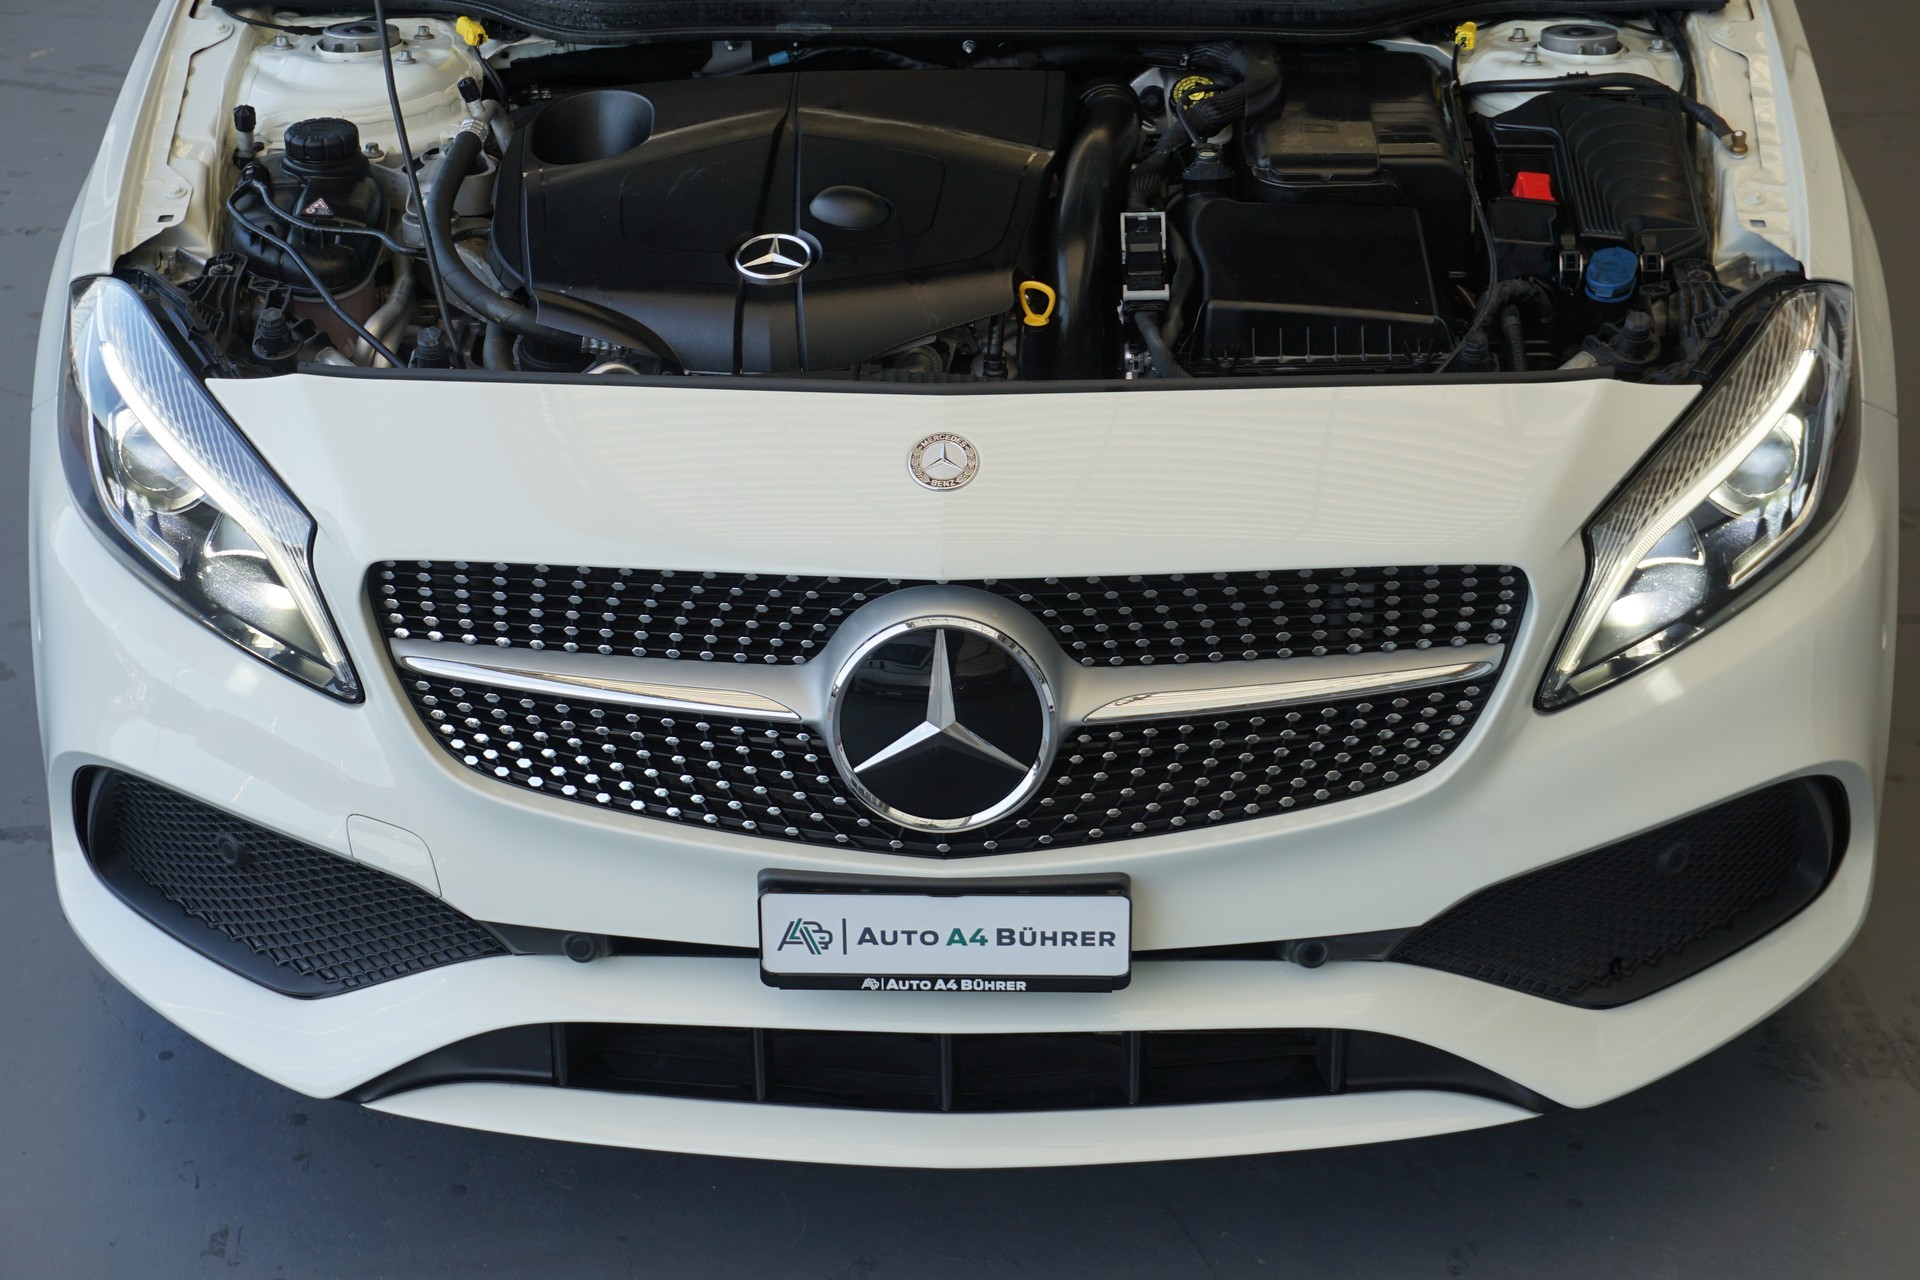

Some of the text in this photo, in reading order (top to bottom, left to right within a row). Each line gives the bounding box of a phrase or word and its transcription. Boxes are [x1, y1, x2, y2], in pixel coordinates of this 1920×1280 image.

[920, 434, 967, 447] MERCEDES
[930, 479, 956, 487] BENZ
[857, 926, 940, 947] AUTO
[946, 927, 989, 947] A4
[995, 927, 1117, 947] BÜHRER
[886, 978, 932, 991] AUTO
[934, 978, 958, 991] A4
[960, 978, 1027, 992] BÜHRER
